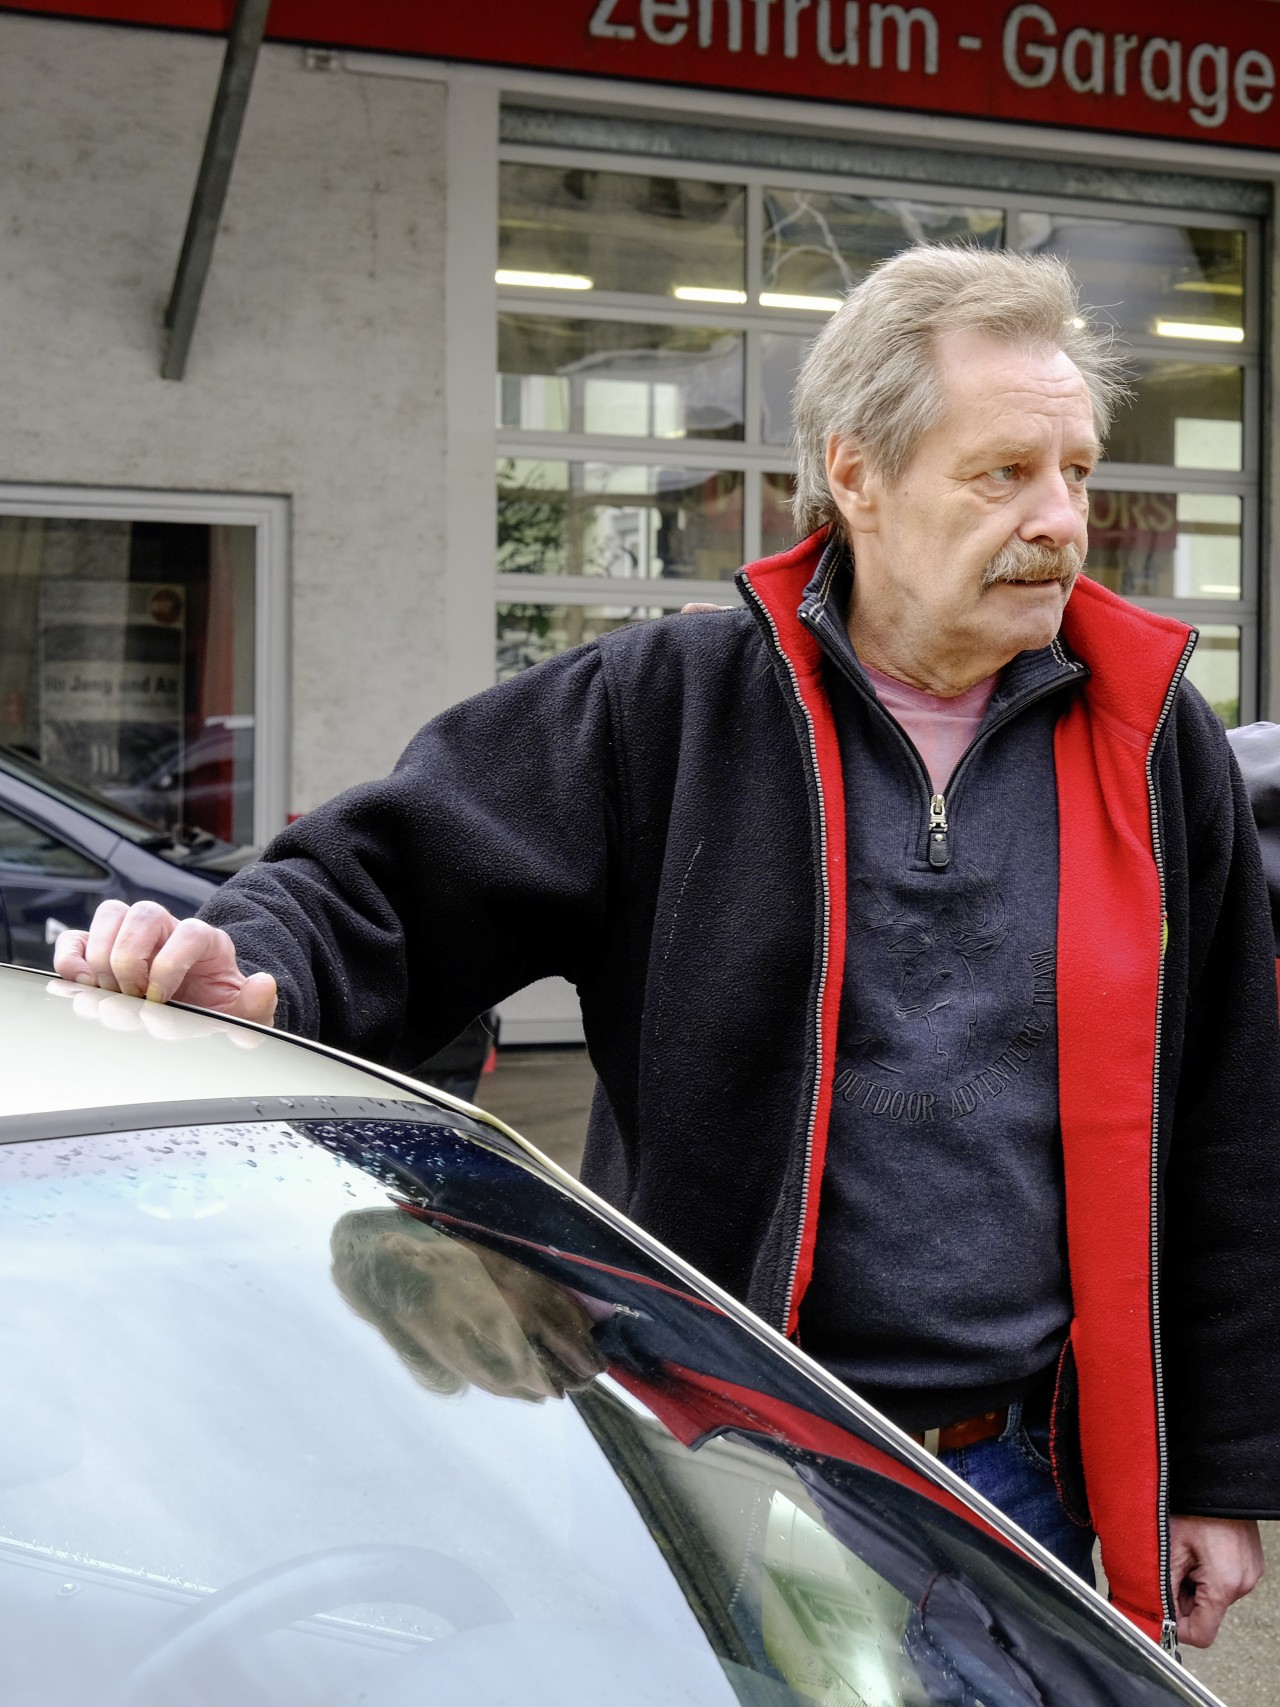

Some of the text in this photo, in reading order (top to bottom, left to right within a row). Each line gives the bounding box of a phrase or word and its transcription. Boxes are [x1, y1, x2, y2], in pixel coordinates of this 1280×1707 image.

[1003, 3, 1276, 127] Garage
[833, 948, 1056, 1122] OUTDOOR ADVENTURE TEAM
